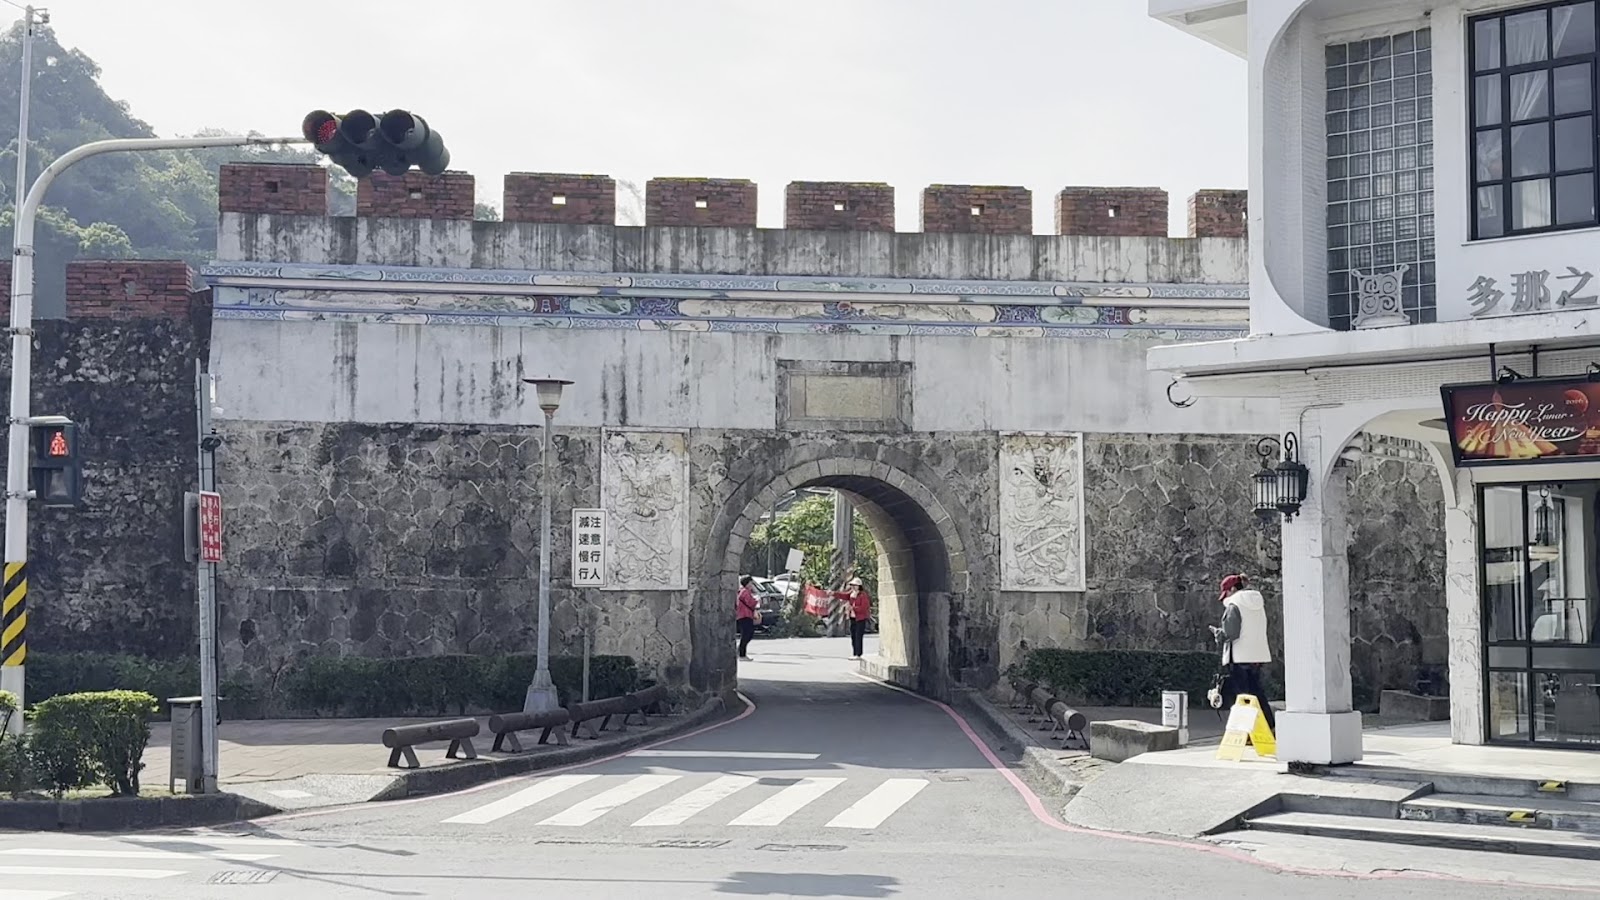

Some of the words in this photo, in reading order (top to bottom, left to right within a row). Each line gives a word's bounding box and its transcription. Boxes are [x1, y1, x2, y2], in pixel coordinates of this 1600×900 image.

[1467, 267, 1598, 316] 多那之
[1462, 402, 1531, 427] Happy
[1531, 404, 1567, 423] Lunar
[1481, 428, 1526, 443] New
[1528, 426, 1587, 443] Year
[579, 516, 590, 580] 減速慢行
[590, 516, 601, 580] 注意行人
